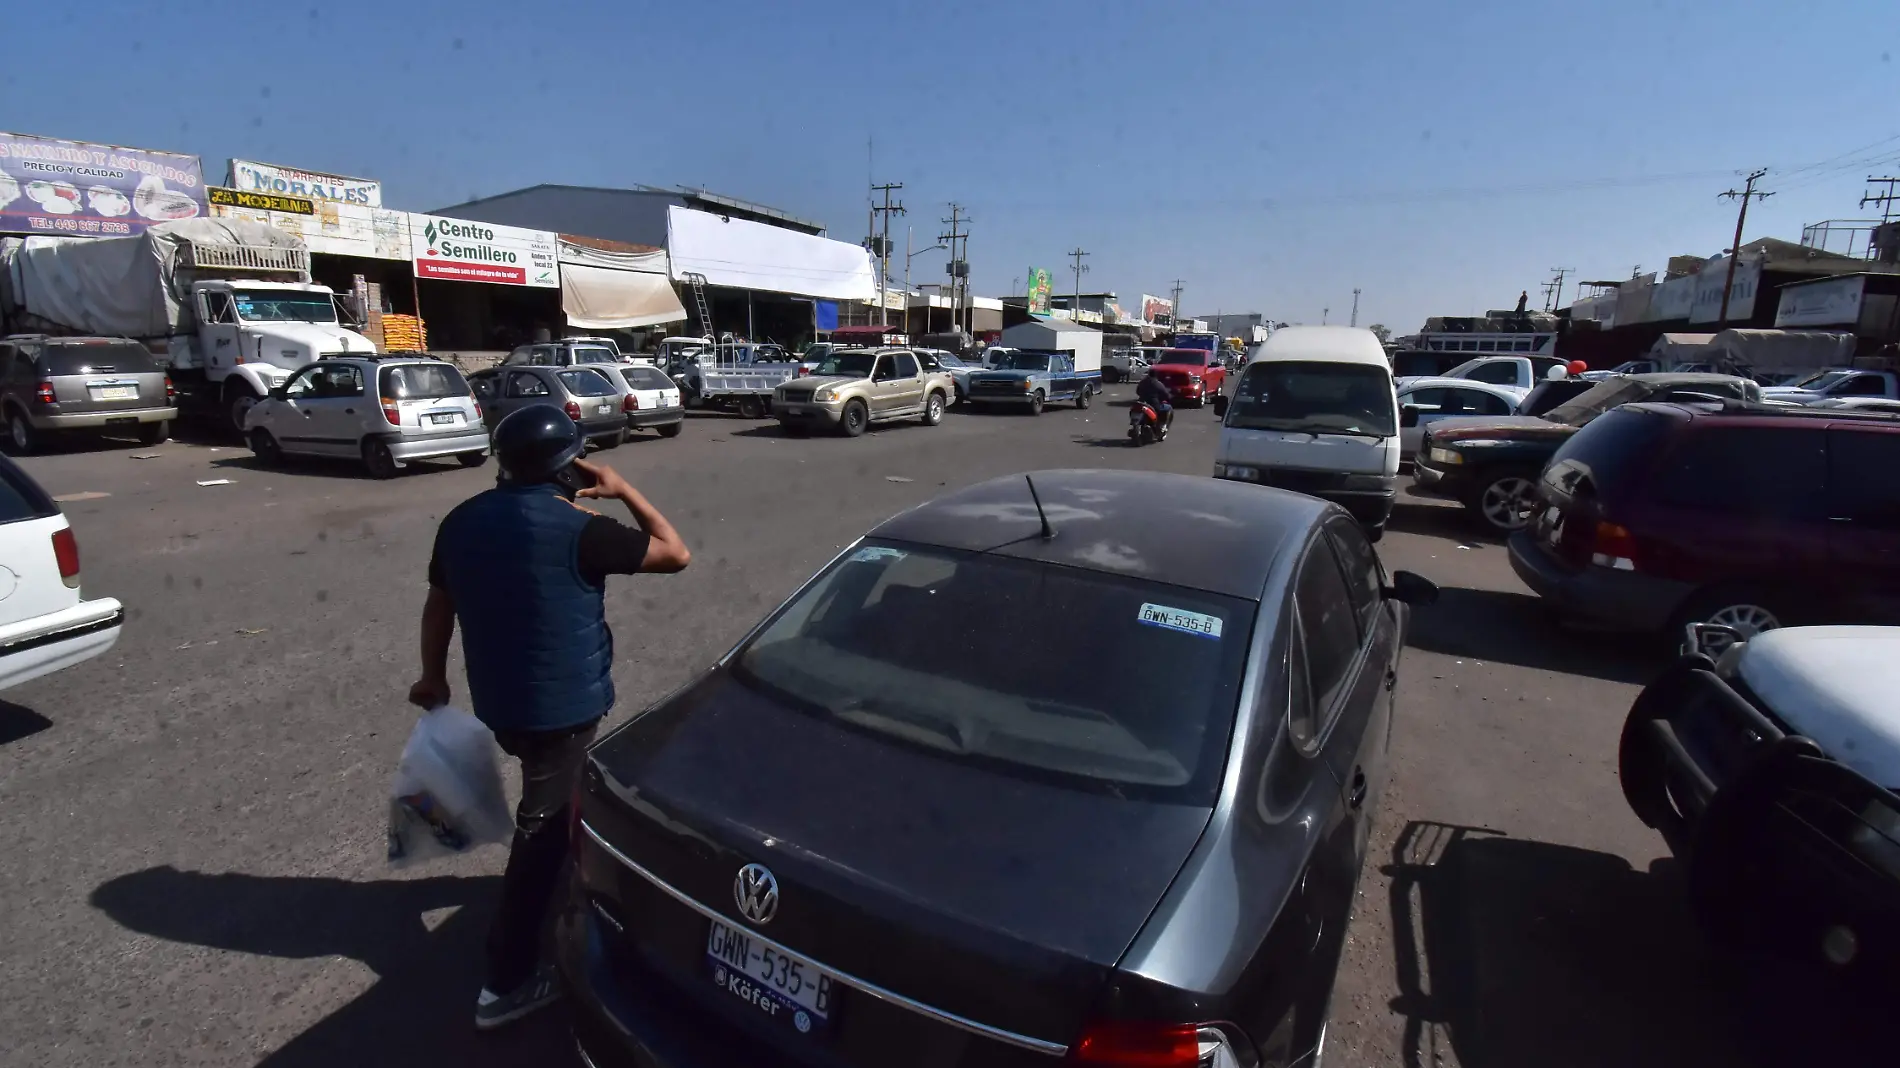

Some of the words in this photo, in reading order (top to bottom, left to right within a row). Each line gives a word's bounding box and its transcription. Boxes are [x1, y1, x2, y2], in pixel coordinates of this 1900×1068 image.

[9, 143, 92, 164] NAVARRO
[93, 152, 107, 166] Y
[108, 154, 197, 188] ASOCIADOS
[24, 161, 65, 173] PRECIO
[66, 166, 74, 174] Y
[76, 167, 124, 179] CALIDAD
[211, 190, 234, 204] LA
[236, 192, 312, 214] MODERNA
[29, 217, 54, 229] TEL:
[55, 219, 77, 231] 449
[102, 222, 130, 234] 2738
[439, 219, 494, 241] Centro
[441, 241, 517, 263] Semillero
[1143, 609, 1212, 634] GWN-535-B
[710, 921, 833, 1013] GWN-535-B
[728, 974, 781, 1016] Käfer
